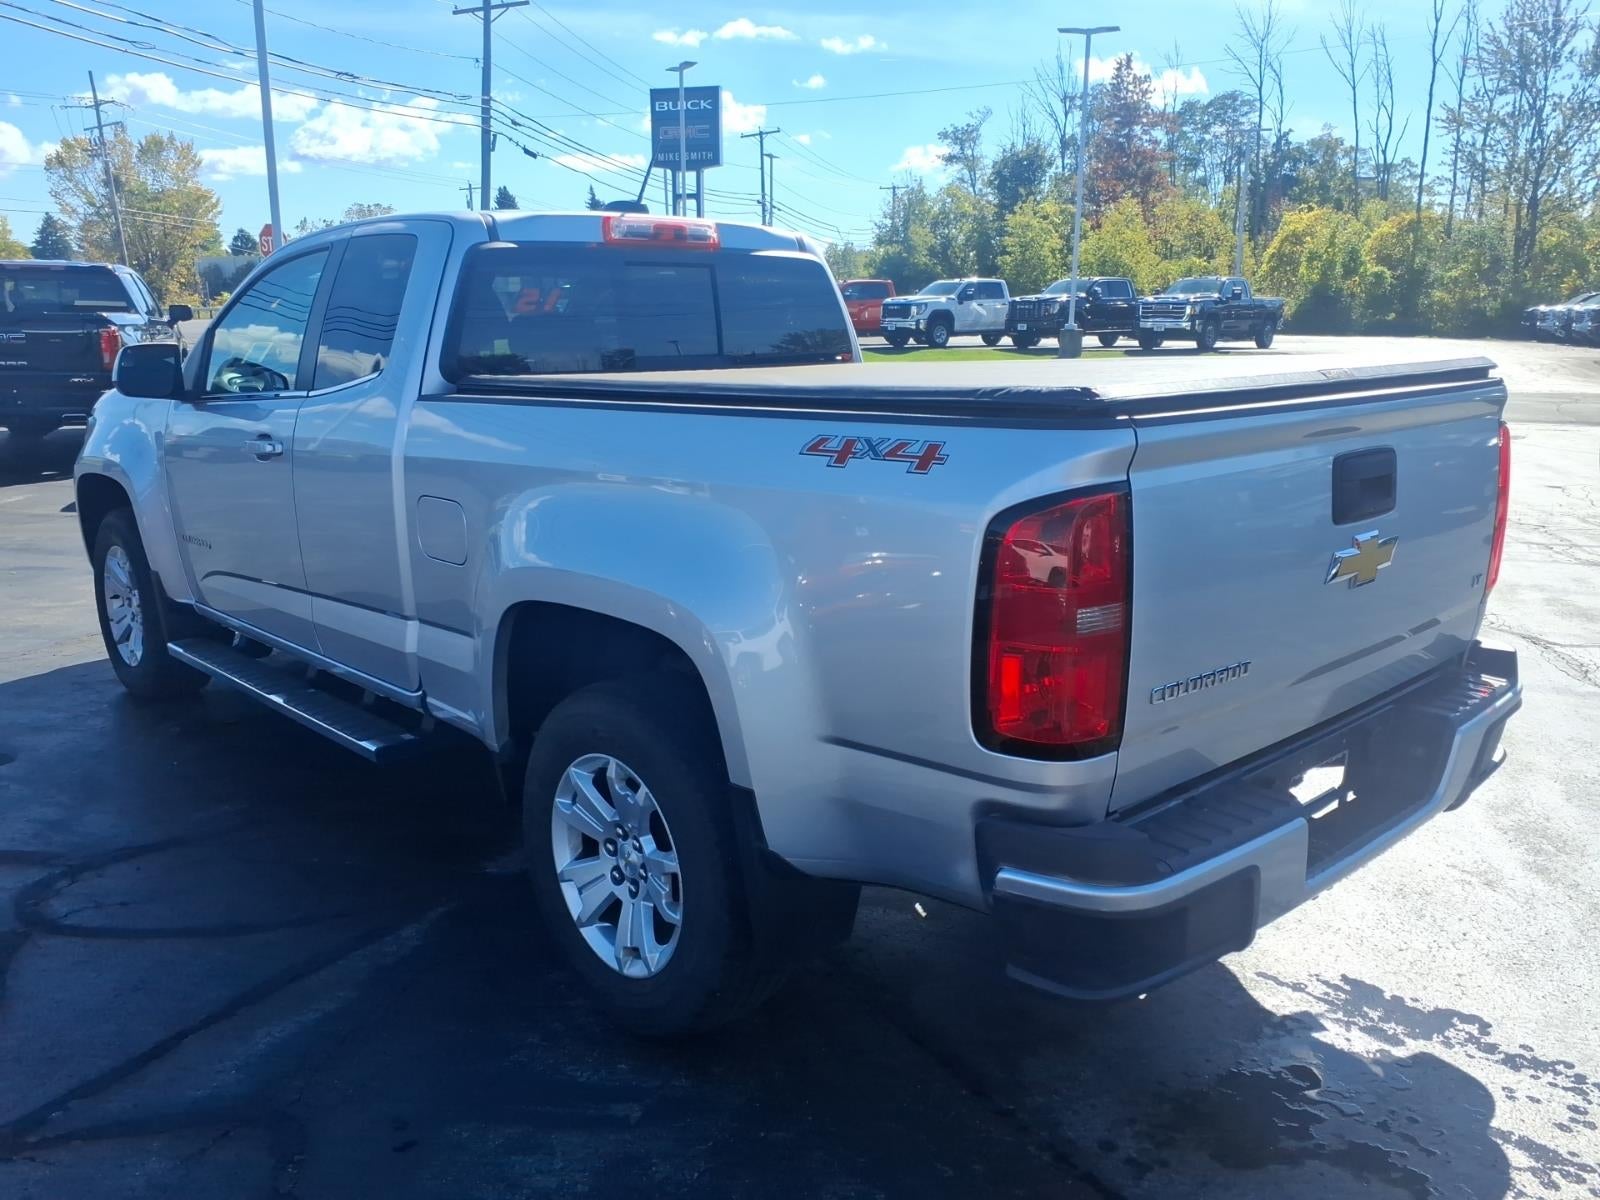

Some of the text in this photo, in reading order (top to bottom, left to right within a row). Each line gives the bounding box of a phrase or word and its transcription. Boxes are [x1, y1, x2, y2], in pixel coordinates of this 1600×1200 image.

[655, 99, 713, 112] BUICK
[659, 125, 710, 140] GMC
[657, 151, 713, 161] MIKE SMITH
[1150, 660, 1251, 705] COLORADO
